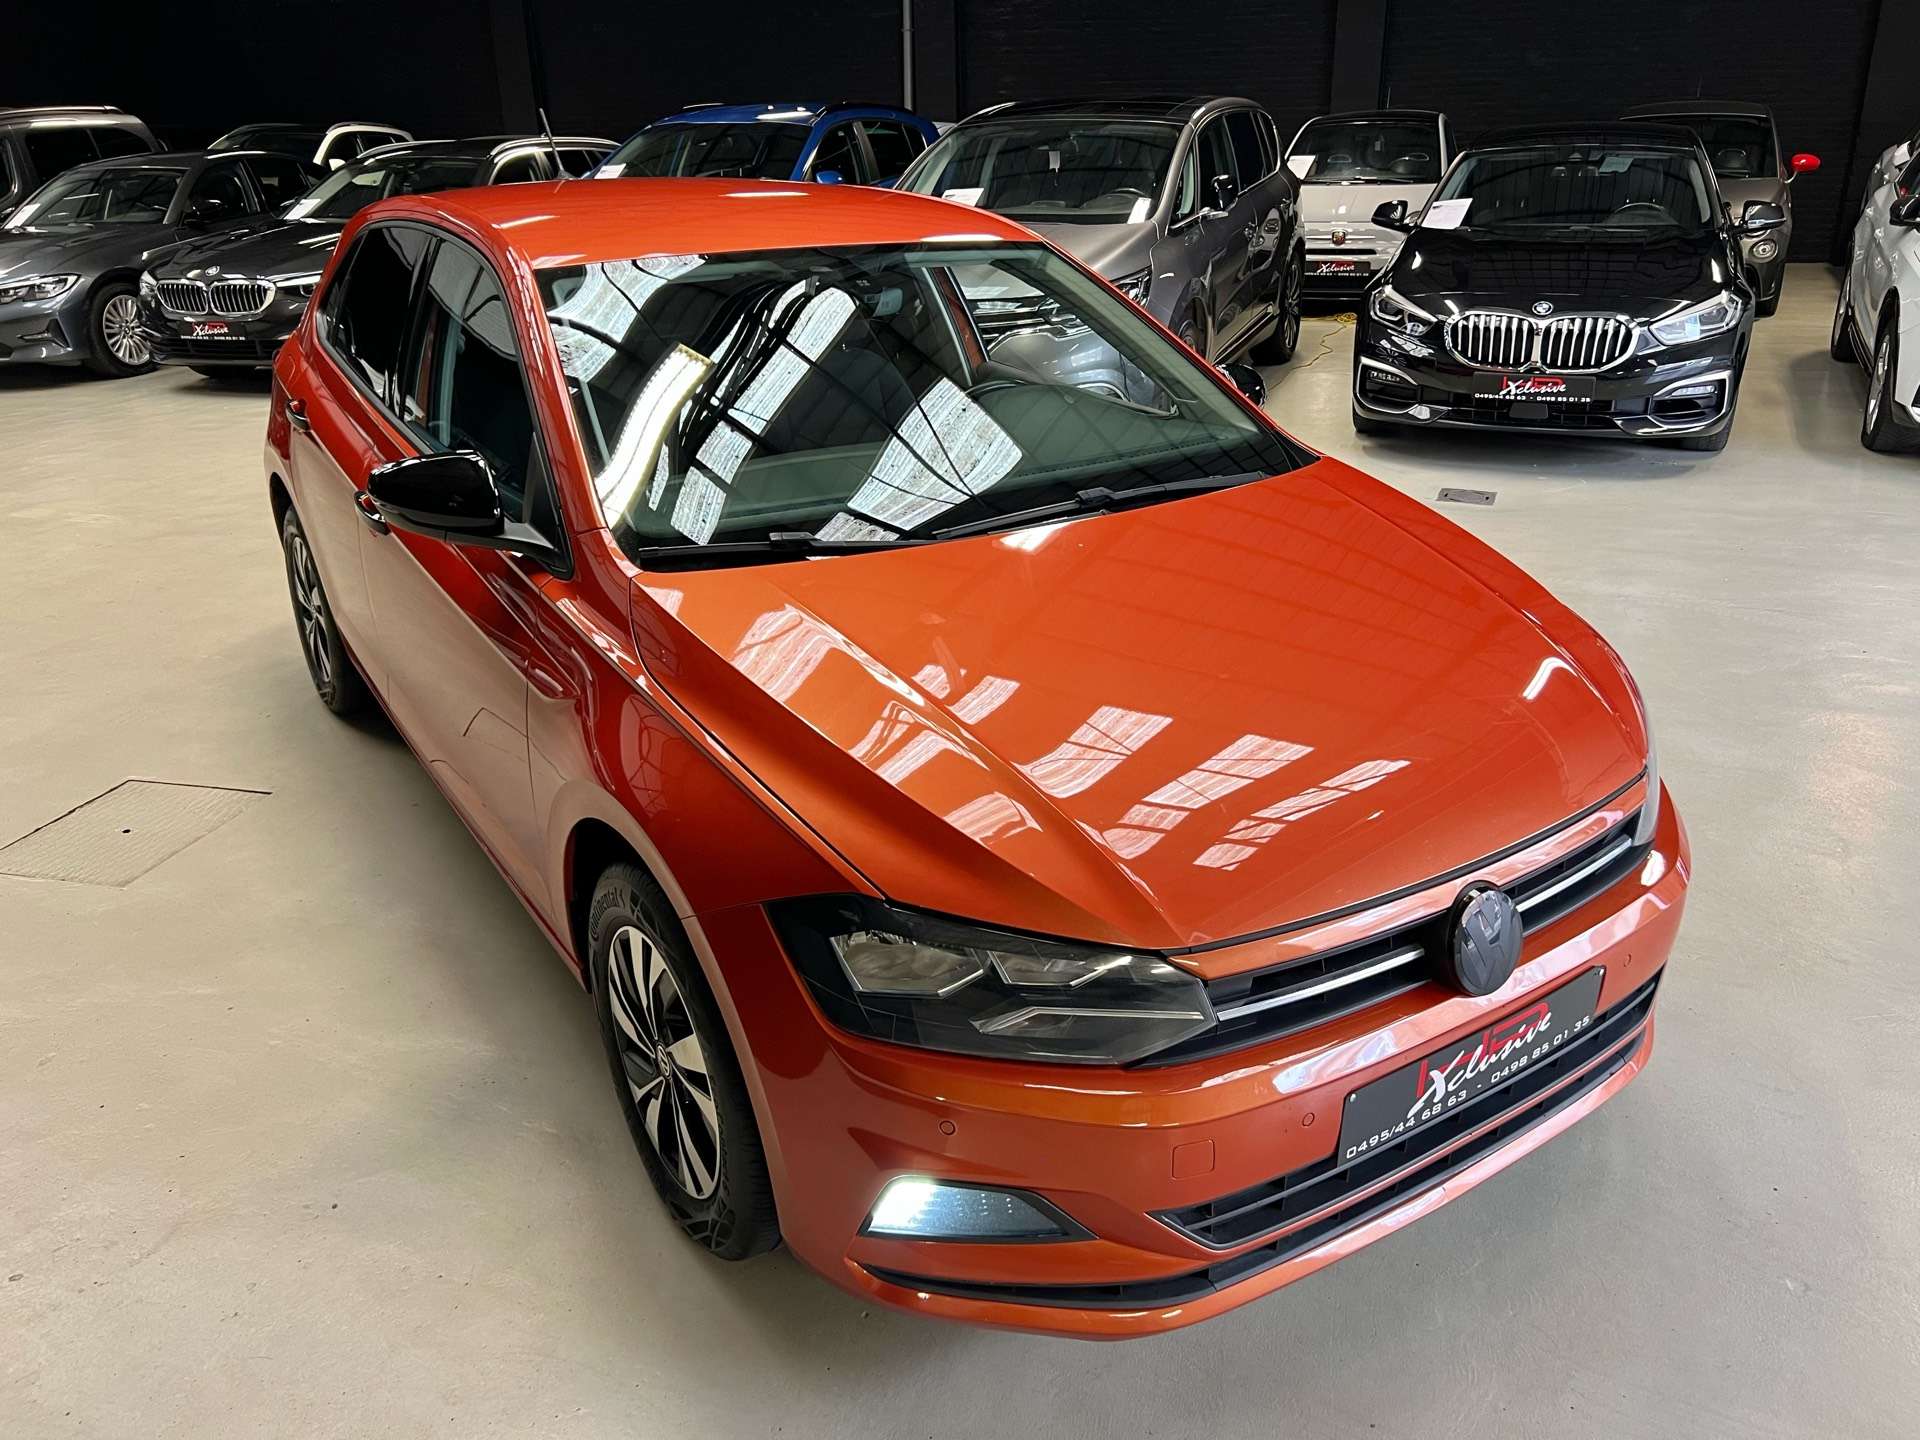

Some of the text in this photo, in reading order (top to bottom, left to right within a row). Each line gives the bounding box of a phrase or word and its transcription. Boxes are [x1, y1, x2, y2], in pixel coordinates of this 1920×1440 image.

[1499, 379, 1567, 396] Xclusive
[1345, 1116, 1417, 1159] 0495/44
[1421, 1102, 1442, 1121] 68
[1447, 1089, 1467, 1107] 63
[1490, 1055, 1528, 1083] 0498
[1532, 1042, 1550, 1059] 85
[1553, 1029, 1568, 1046] 01
[1573, 1015, 1590, 1032] 35
[1407, 1012, 1552, 1119] Xclusive
